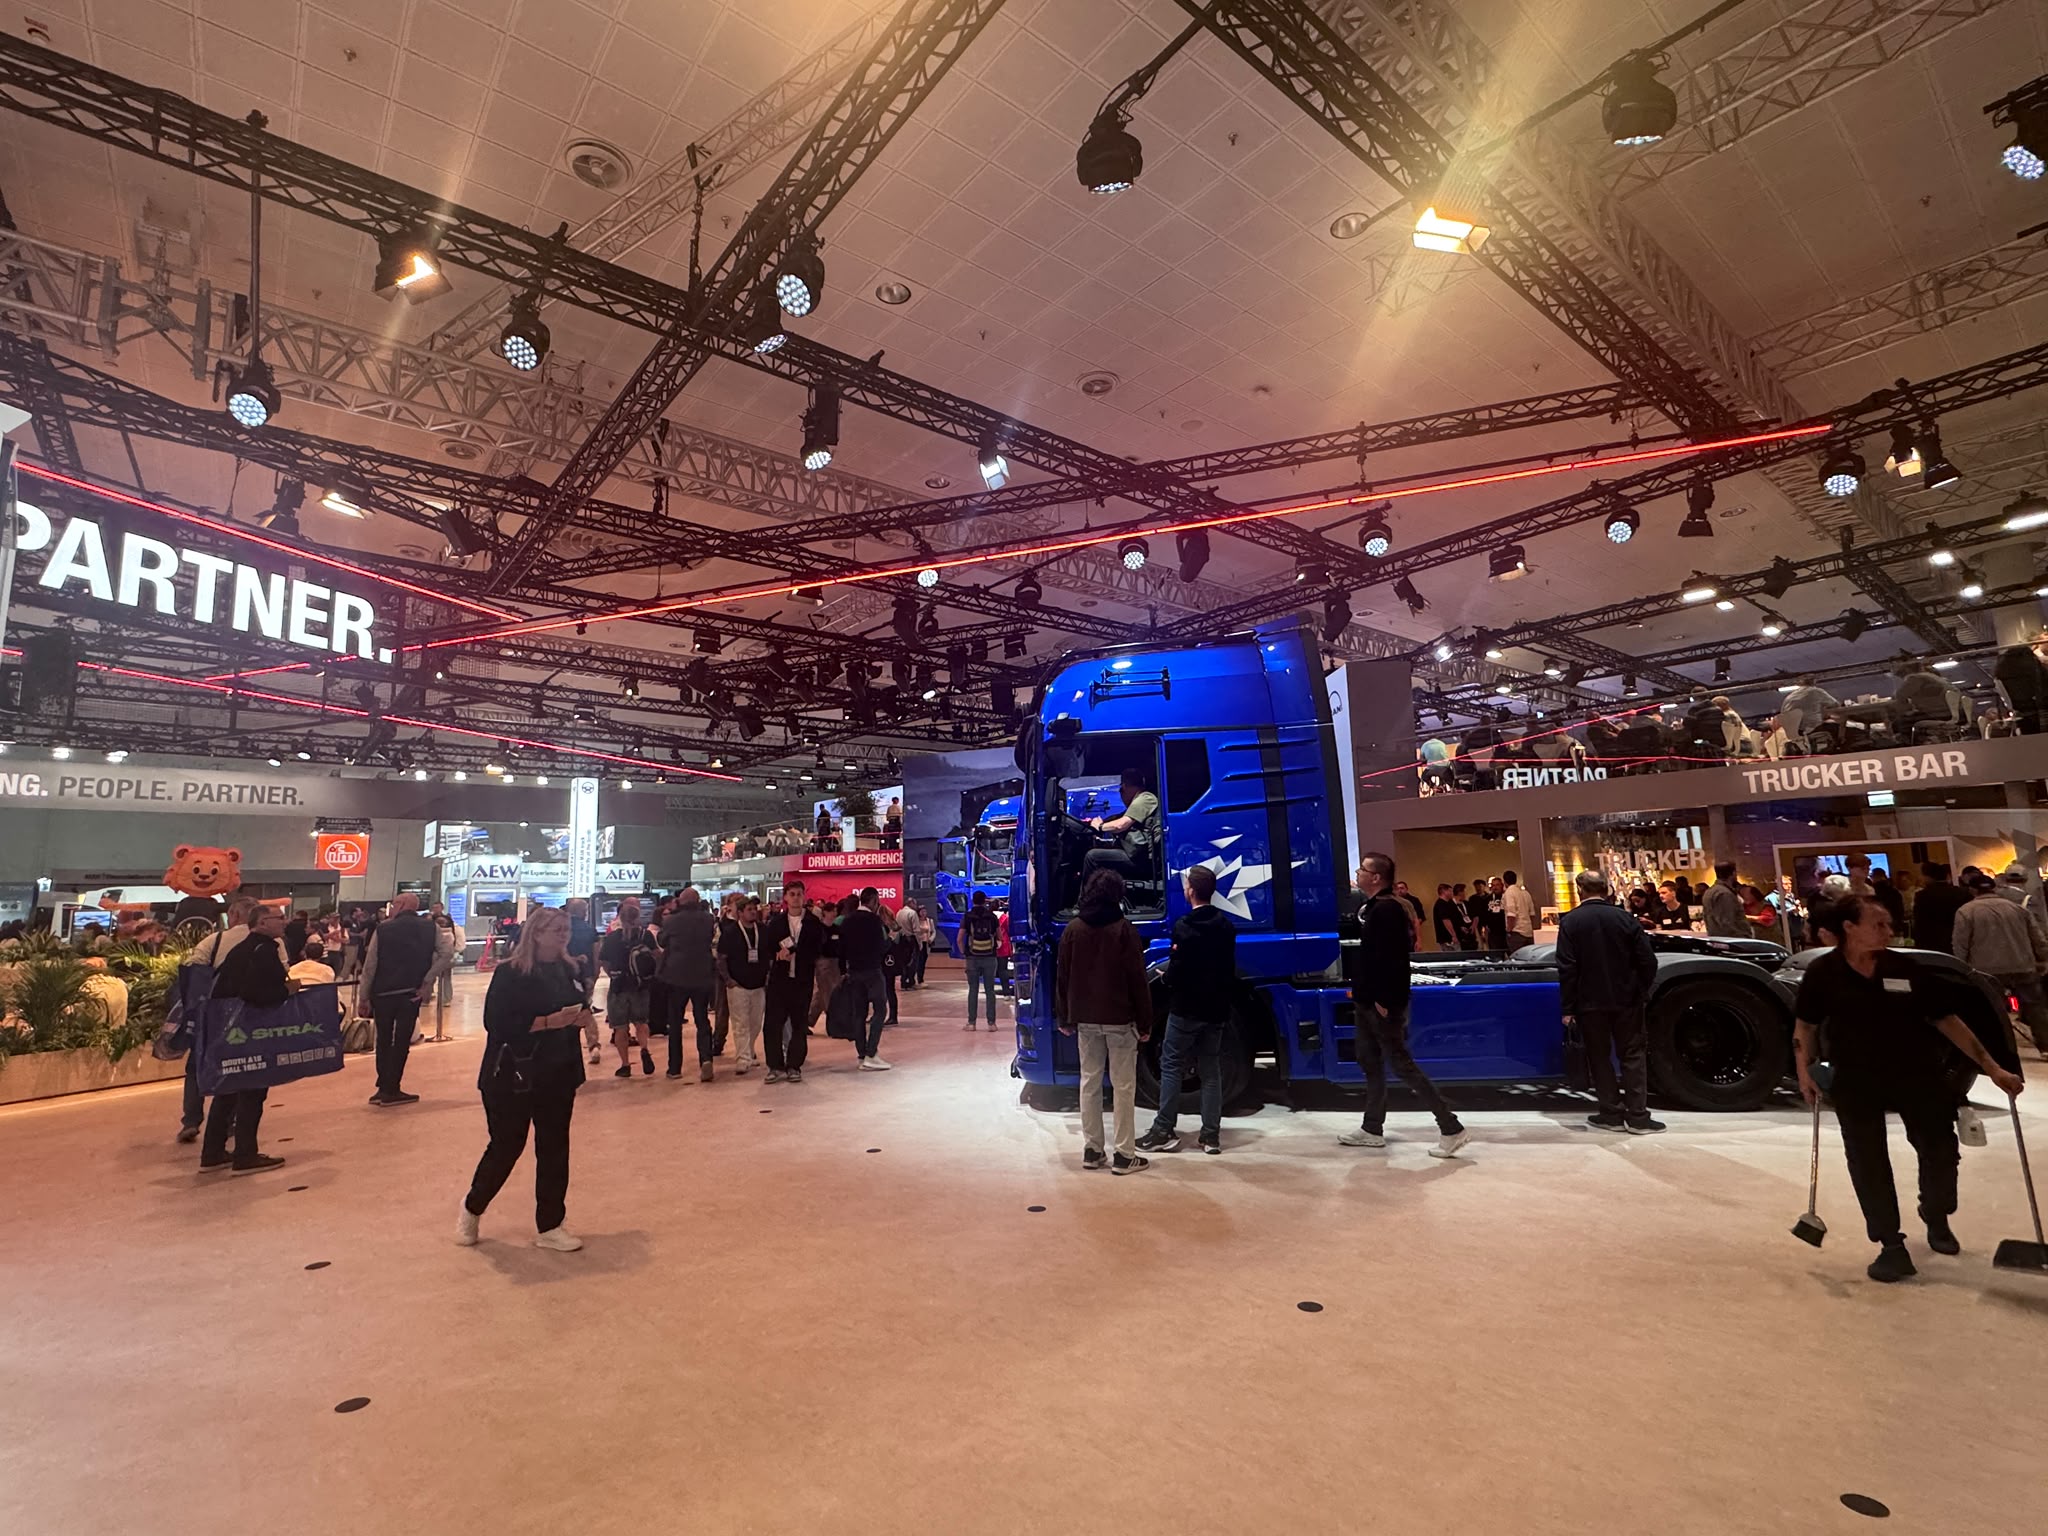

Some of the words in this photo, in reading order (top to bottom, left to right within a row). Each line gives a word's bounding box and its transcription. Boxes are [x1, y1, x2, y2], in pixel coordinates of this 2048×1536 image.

[17, 500, 396, 664] PARTNER.
[1742, 759, 1884, 793] TRUCKER
[1894, 750, 1969, 782] BAR
[58, 776, 173, 801] PEOPLE.
[182, 782, 304, 806] PARTNER.
[328, 843, 358, 864] ifm
[808, 856, 845, 867] DRIVING
[848, 853, 903, 865] EXPERIENCE
[1594, 847, 1708, 873] TRUCKER
[471, 864, 519, 878] AEW
[530, 869, 559, 877] Experience
[606, 869, 640, 880] AEW
[251, 1022, 324, 1040] SITRAK
[222, 1065, 242, 1076] HALL
